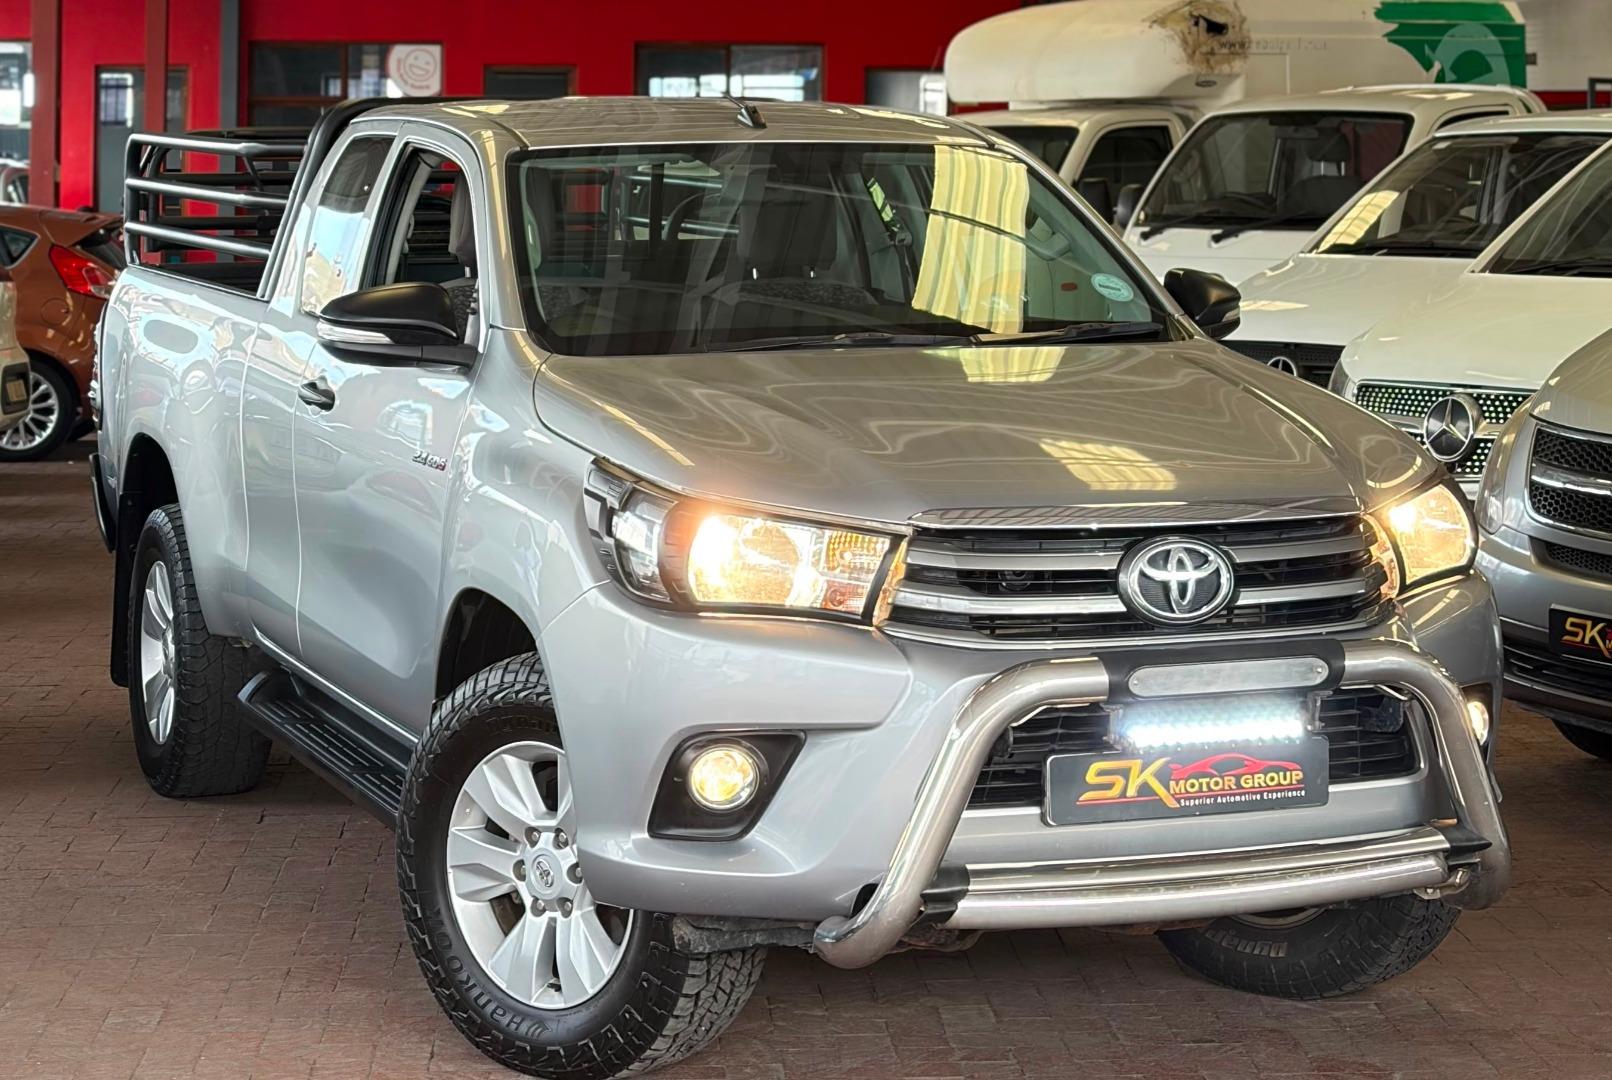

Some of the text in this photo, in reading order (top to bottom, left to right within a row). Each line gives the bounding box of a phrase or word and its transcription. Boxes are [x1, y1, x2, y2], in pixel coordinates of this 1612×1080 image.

[1561, 617, 1612, 659] SK
[1077, 757, 1180, 808] SK
[1169, 770, 1304, 795] MOTOR GROUP
[1180, 790, 1306, 806] Superior Automotive Experience
